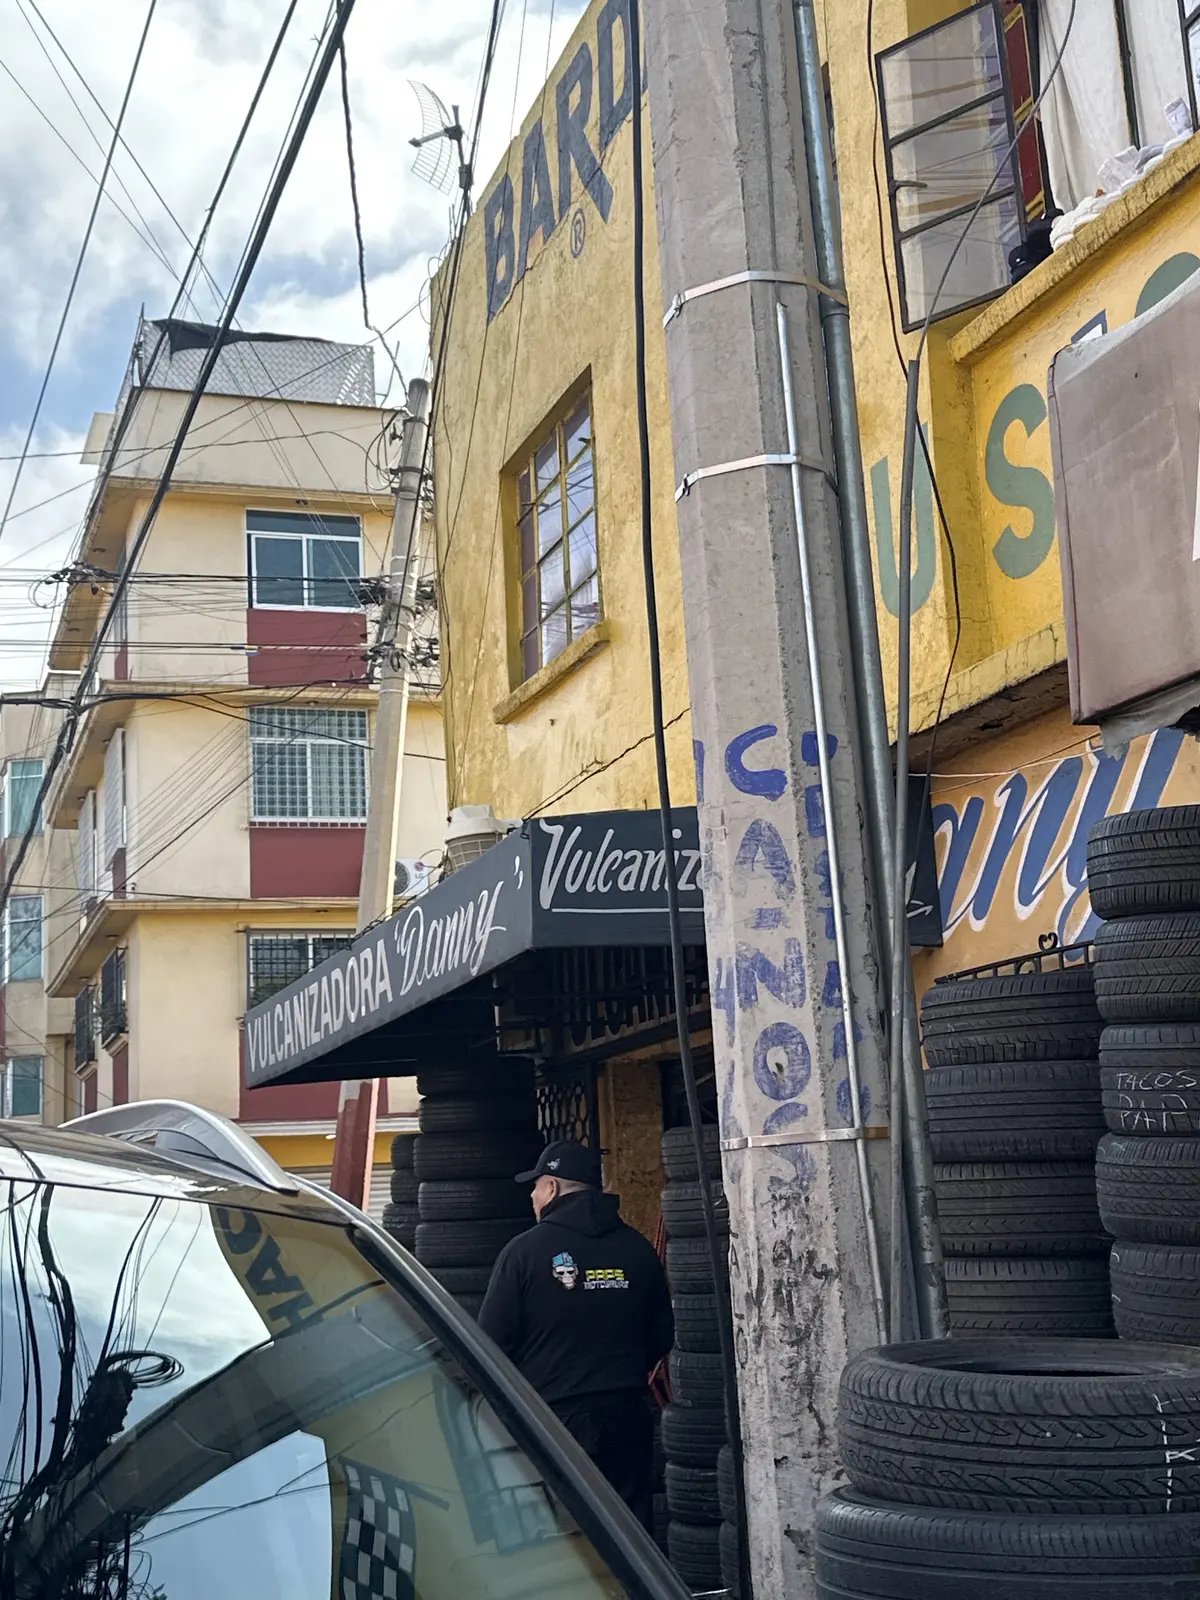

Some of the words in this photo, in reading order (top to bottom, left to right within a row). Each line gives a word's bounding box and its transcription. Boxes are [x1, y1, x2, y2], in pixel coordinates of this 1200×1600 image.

[484, 0, 648, 327] BARD
[539, 818, 704, 910] Vulcaniz
[247, 938, 393, 1073] VULCANIZADORA
